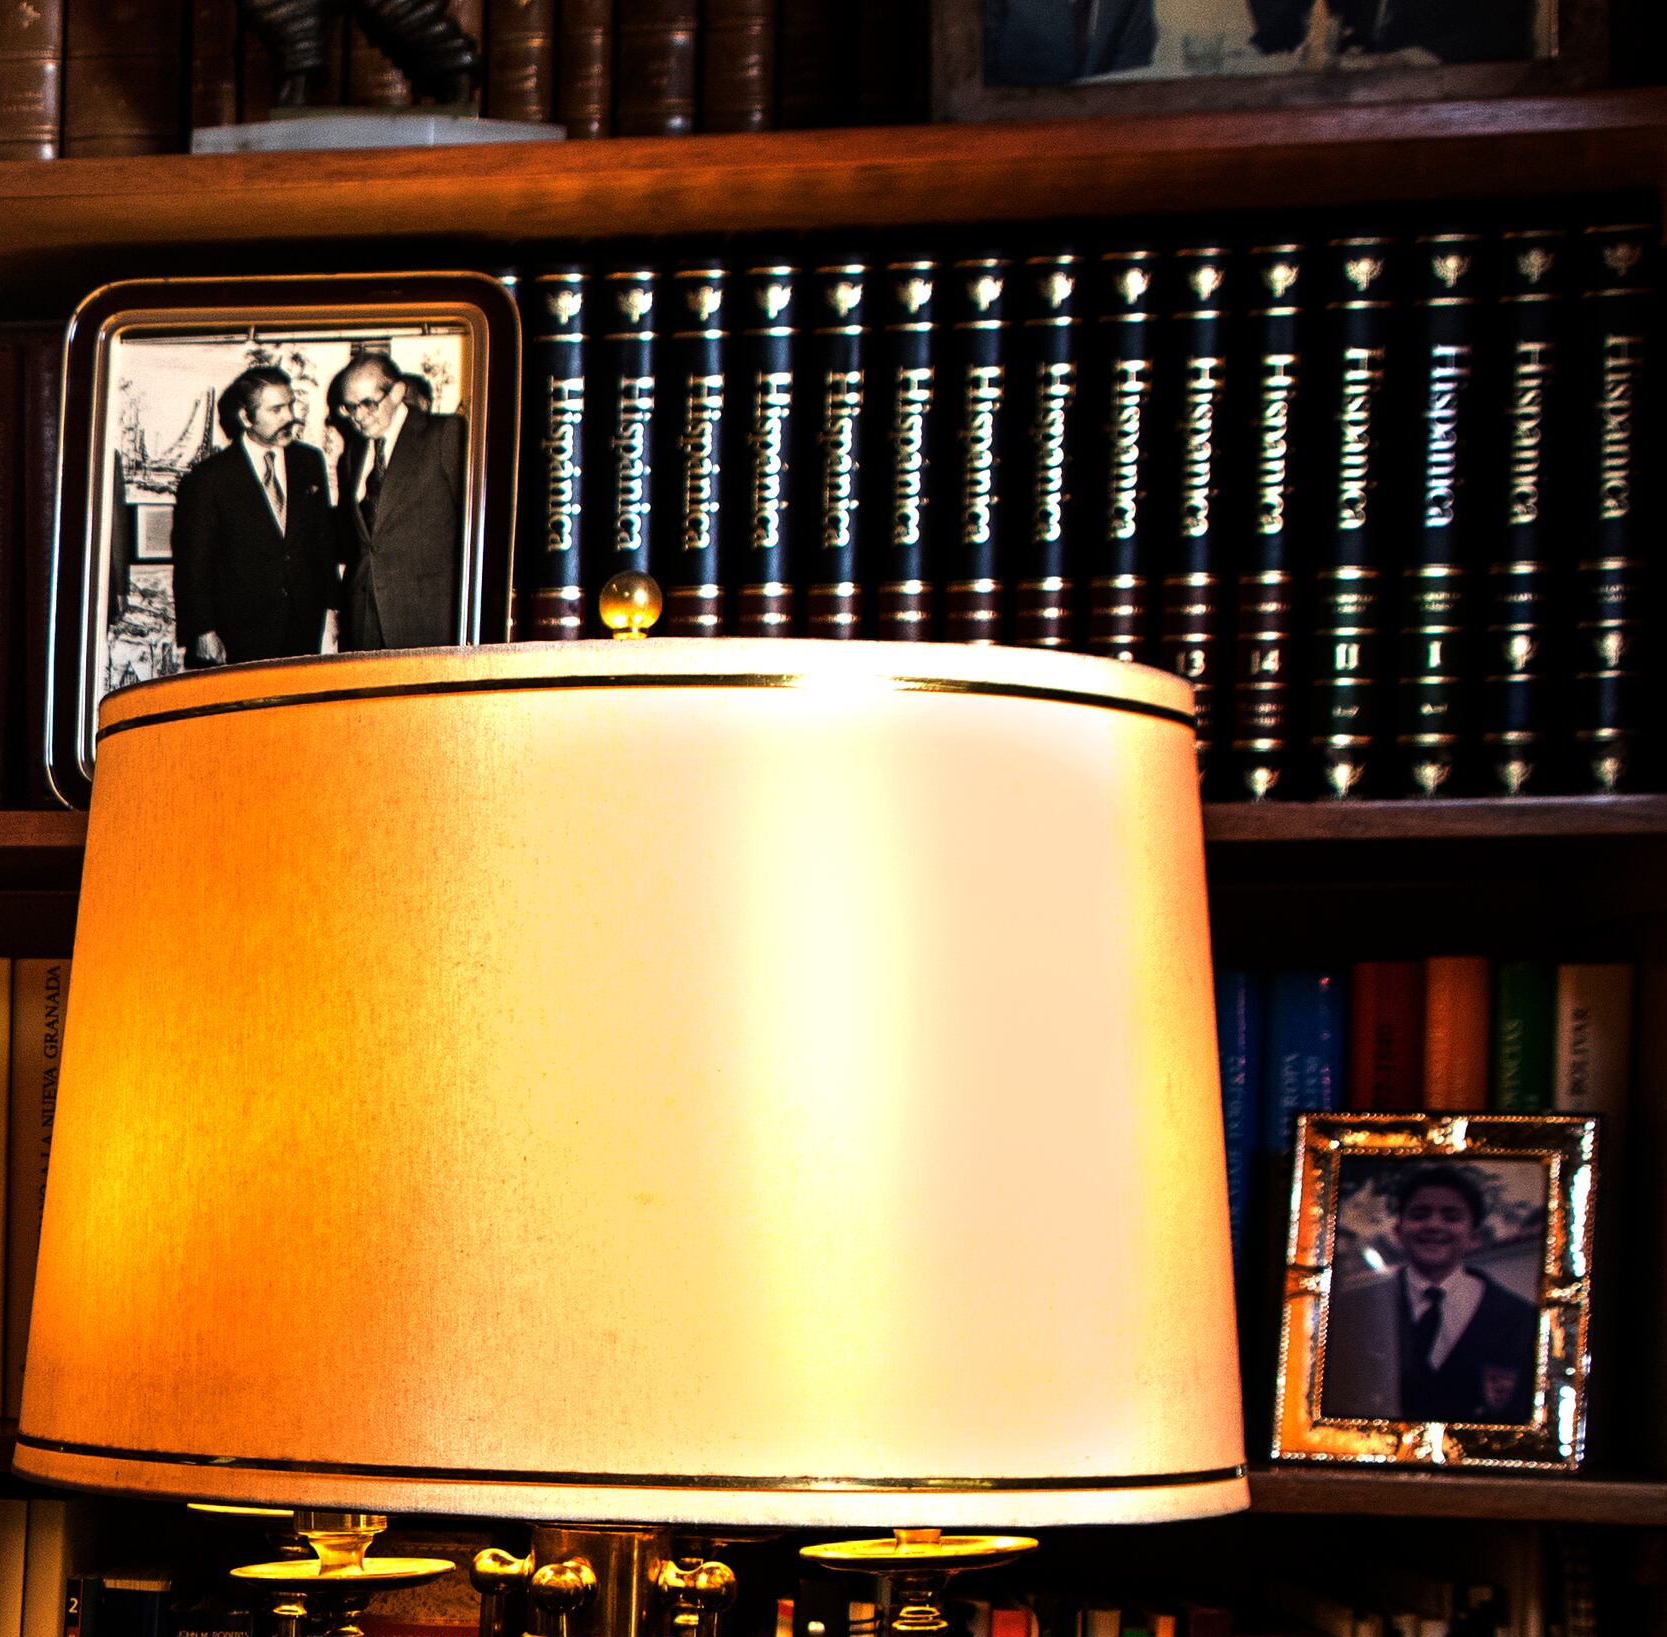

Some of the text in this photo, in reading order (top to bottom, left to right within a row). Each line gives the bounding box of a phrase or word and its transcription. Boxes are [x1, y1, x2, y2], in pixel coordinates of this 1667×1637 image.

[541, 374, 584, 552] Hispánica
[608, 374, 655, 552] Hispánica
[677, 372, 724, 552] Hispánica
[1251, 649, 1283, 676] 14
[68, 1597, 79, 1614] 2
